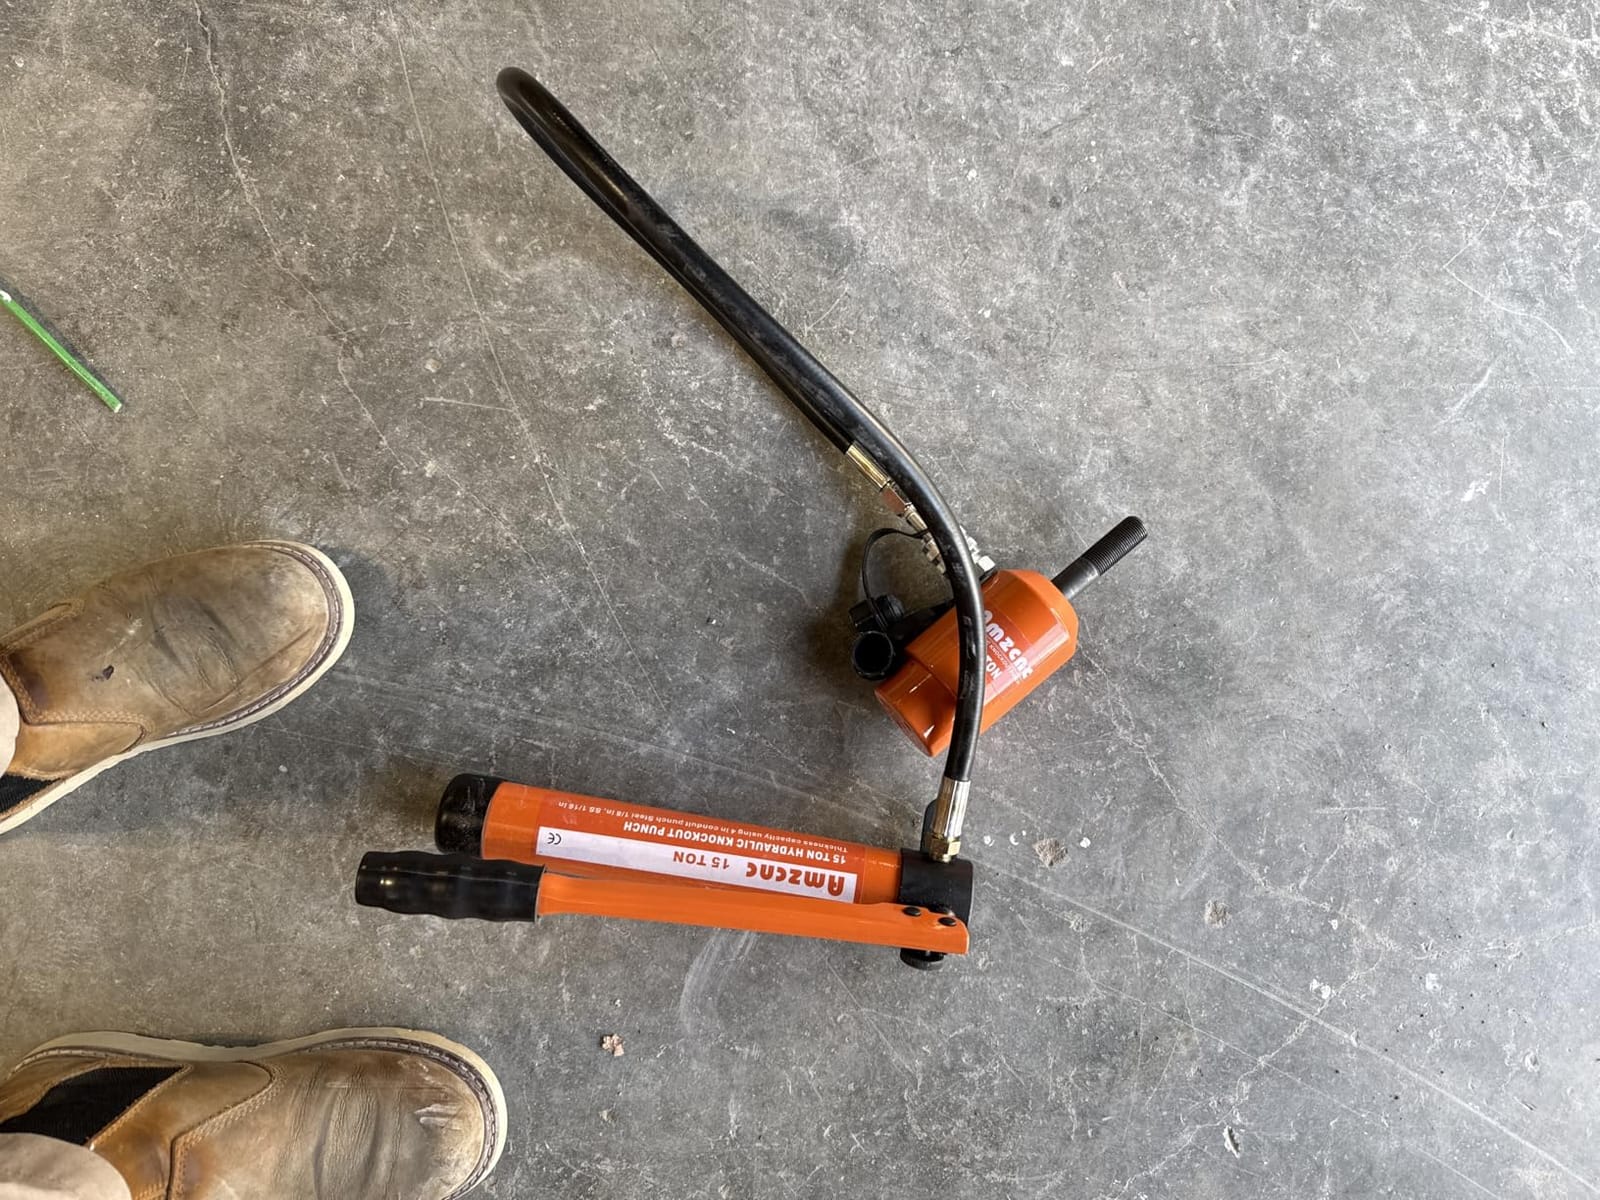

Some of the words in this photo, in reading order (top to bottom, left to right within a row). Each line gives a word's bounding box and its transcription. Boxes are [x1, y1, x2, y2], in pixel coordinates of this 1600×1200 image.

[558, 801, 568, 809] in
[655, 815, 684, 826] punch
[684, 820, 719, 831] conduit
[623, 821, 666, 837] PUNCH
[720, 826, 730, 834] in
[737, 828, 763, 838] using
[667, 828, 734, 847] KNOCKOUT
[763, 832, 801, 845] capacity
[736, 838, 804, 858] HYDRAULIC
[803, 840, 848, 853] Thickness
[673, 851, 707, 866] TON
[806, 849, 831, 862] TON
[833, 853, 846, 865] 15
[711, 856, 730, 870] 15
[745, 861, 845, 897] Amzcnc
